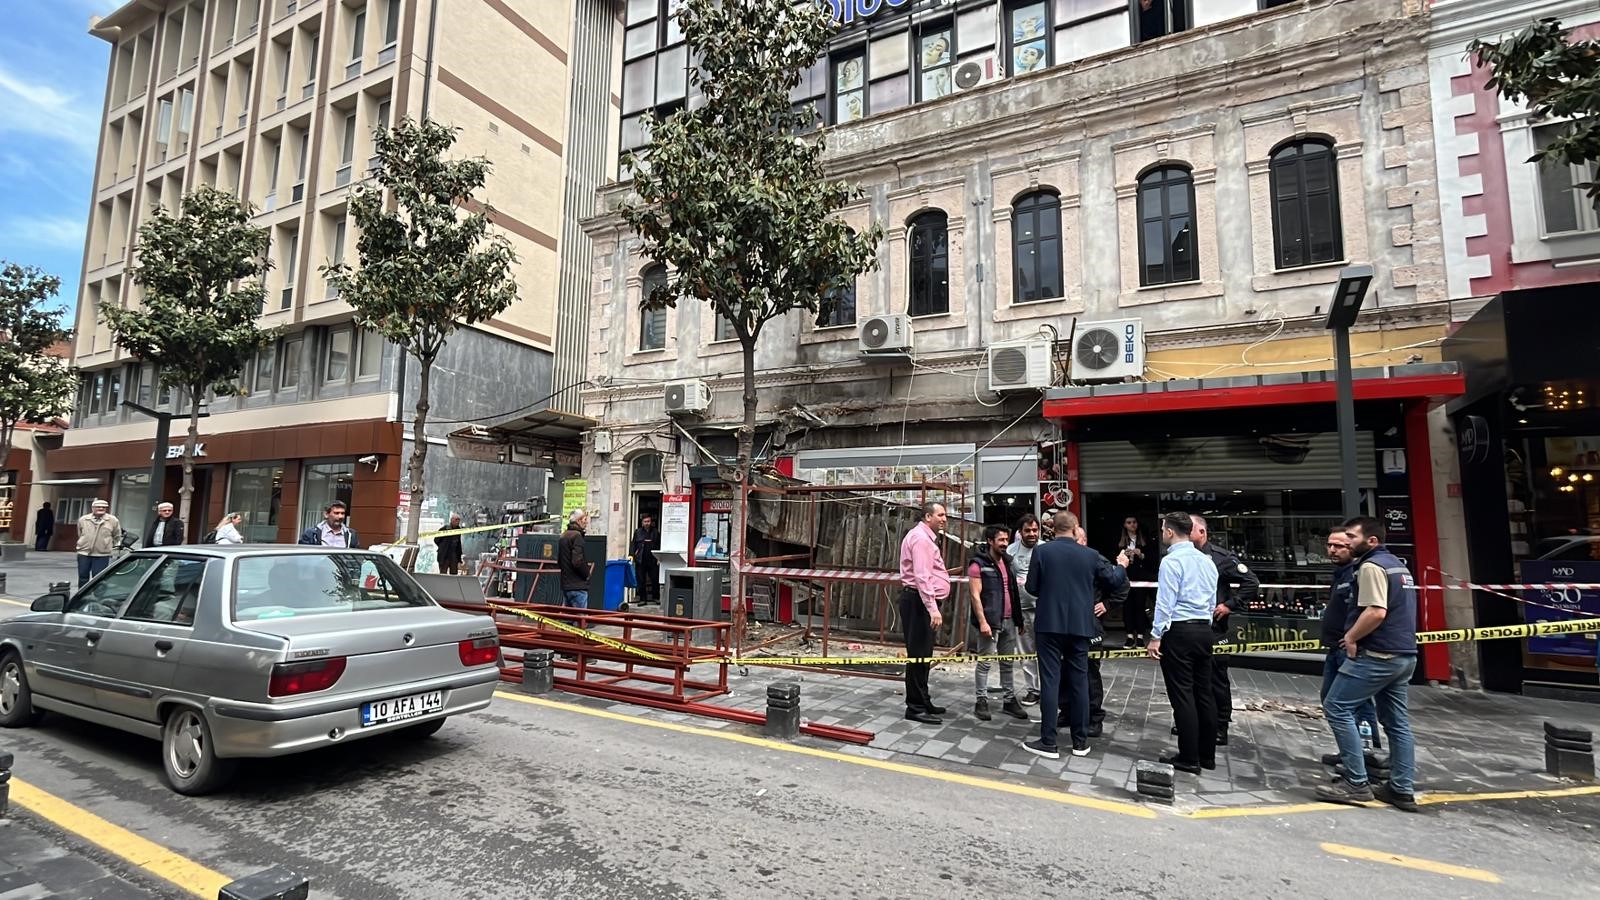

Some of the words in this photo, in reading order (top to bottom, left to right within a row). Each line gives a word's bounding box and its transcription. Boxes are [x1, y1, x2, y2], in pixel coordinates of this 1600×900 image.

[1125, 324, 1134, 364] BEKO
[150, 442, 208, 460] BAK
[1542, 619, 1600, 633] İRİLMEZ
[373, 703, 388, 718] 10
[392, 697, 415, 714] AFA
[421, 691, 440, 708] 144
